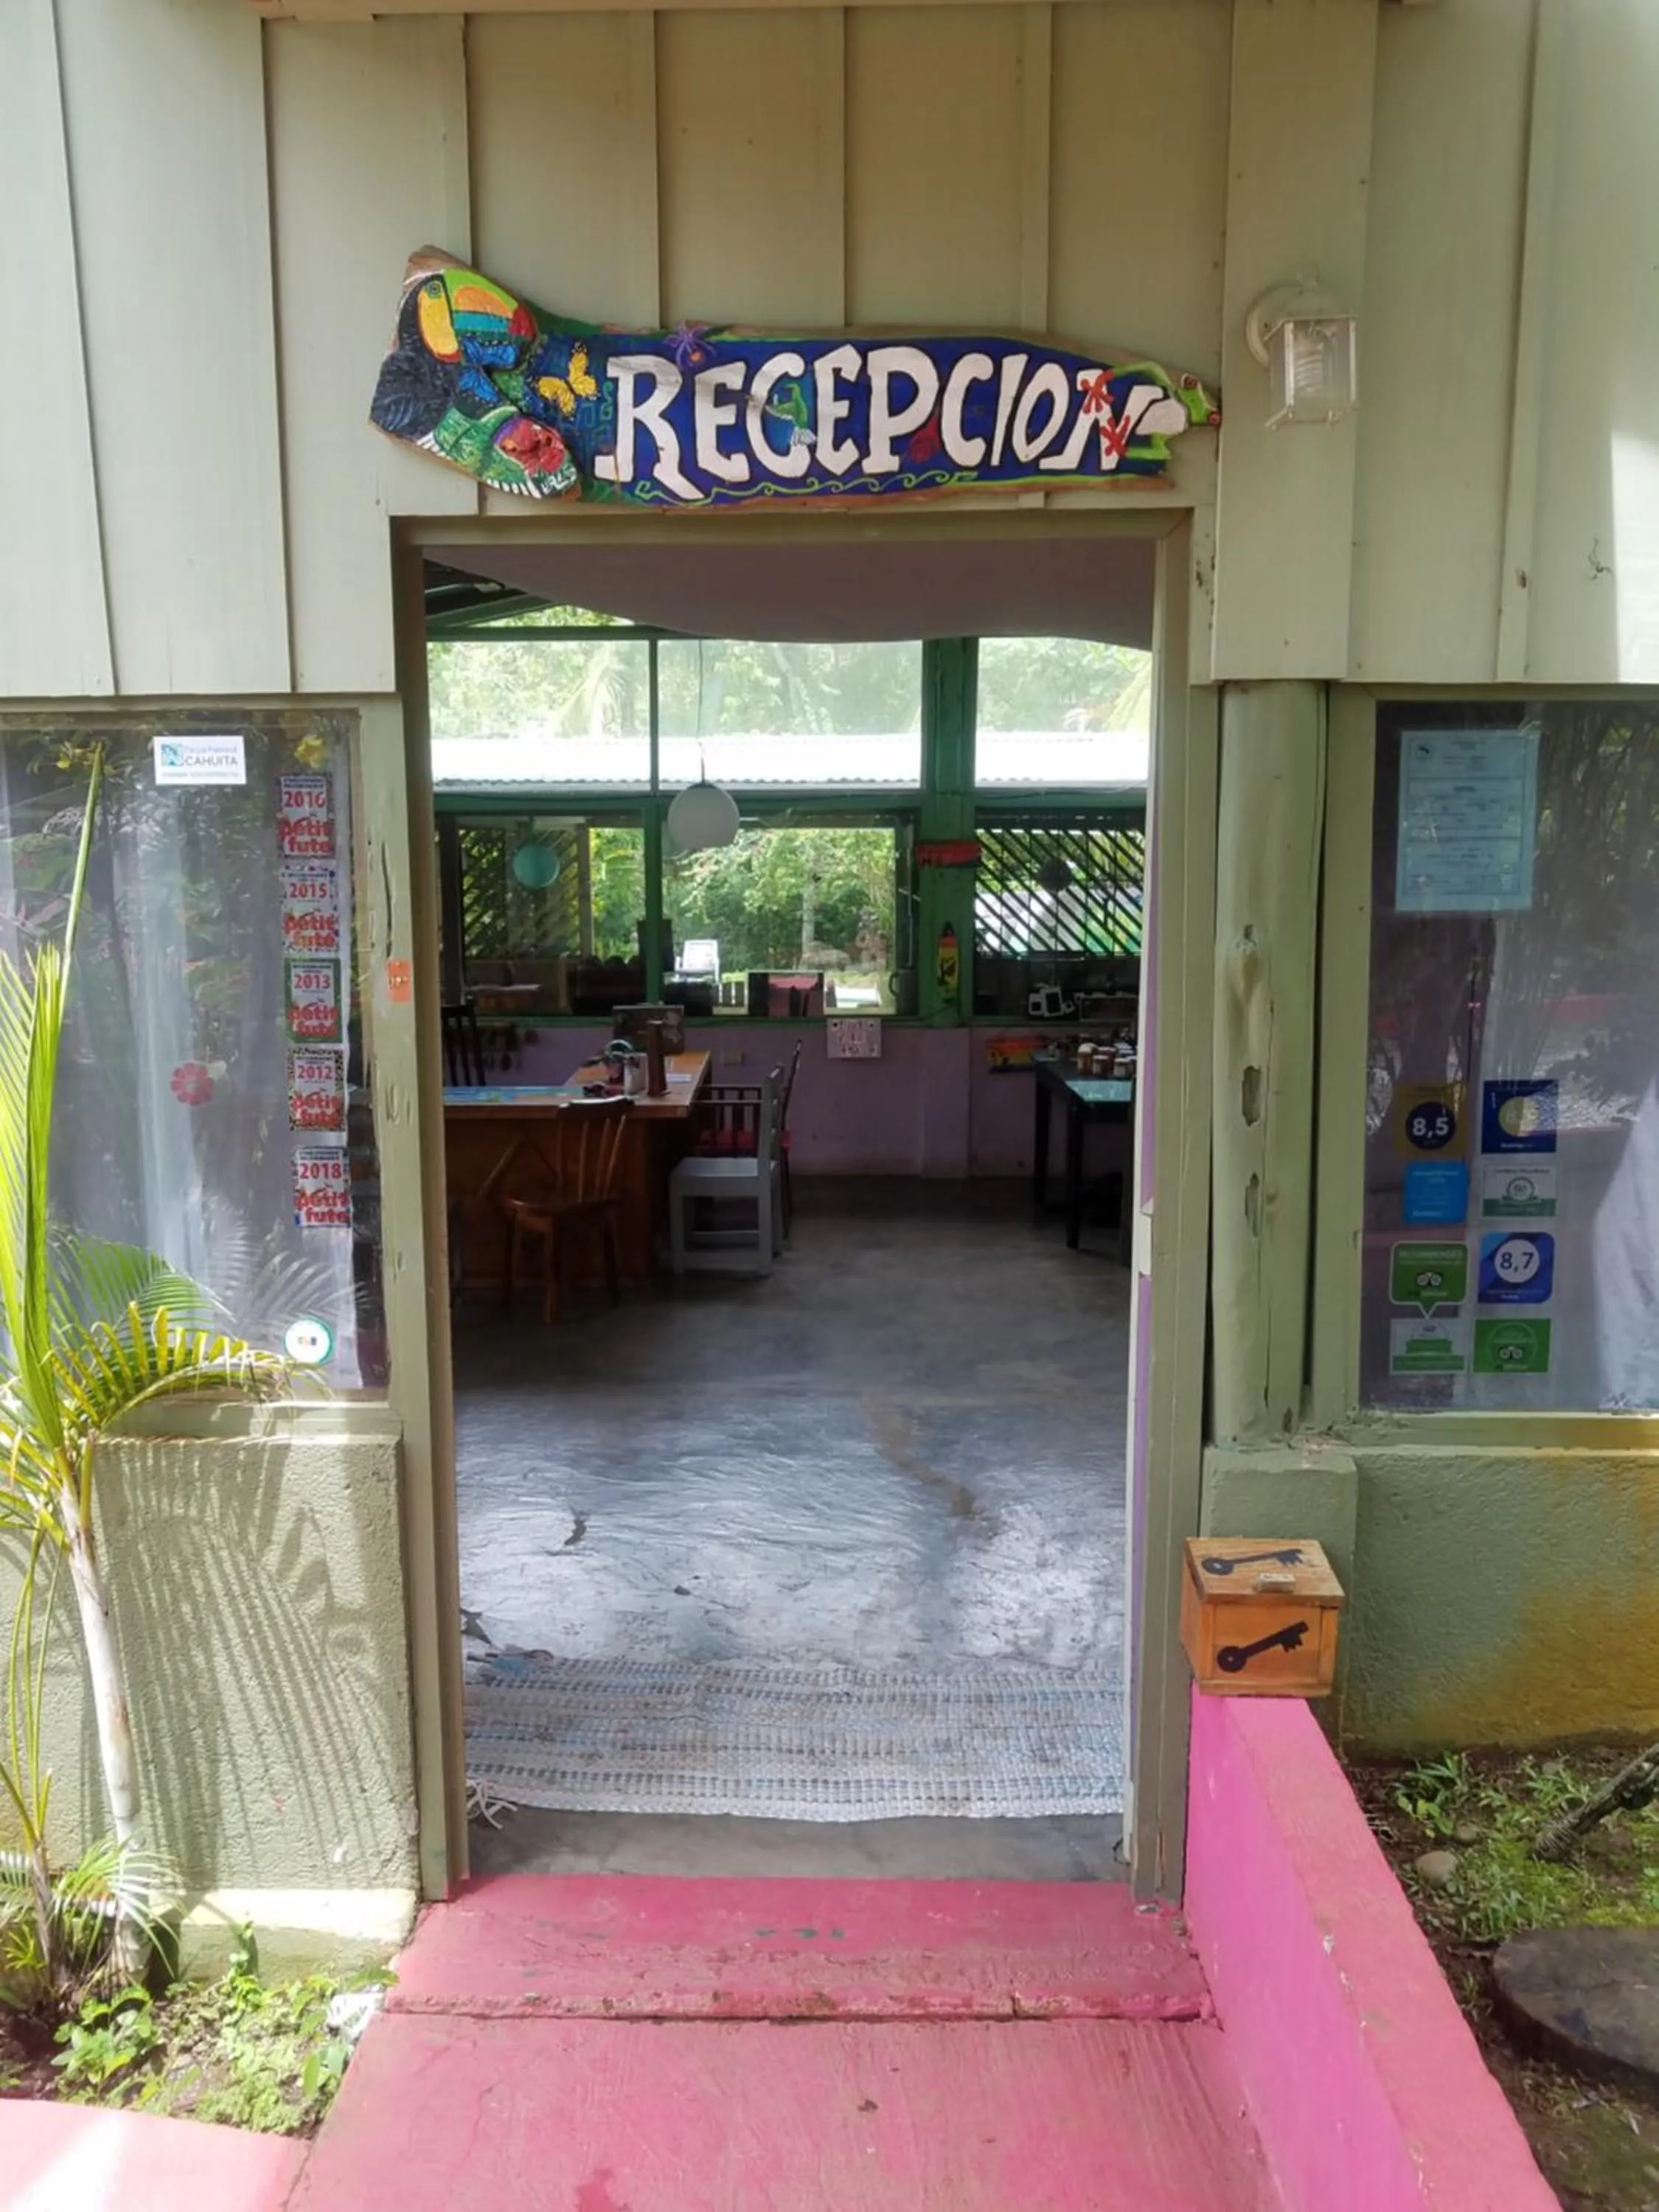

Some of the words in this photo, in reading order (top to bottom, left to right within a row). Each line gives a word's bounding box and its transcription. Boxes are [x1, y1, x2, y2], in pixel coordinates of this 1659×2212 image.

[594, 344, 1164, 500] RECEPCION
[186, 755, 238, 766] CAHUITA
[284, 790, 325, 807] 2016
[290, 883, 327, 898] 2015
[294, 974, 330, 989] 2013
[297, 1065, 333, 1079] 2012
[1413, 1116, 1450, 1138] 8,5
[300, 1163, 341, 1179] 2018
[1500, 1252, 1534, 1273] 8,7
